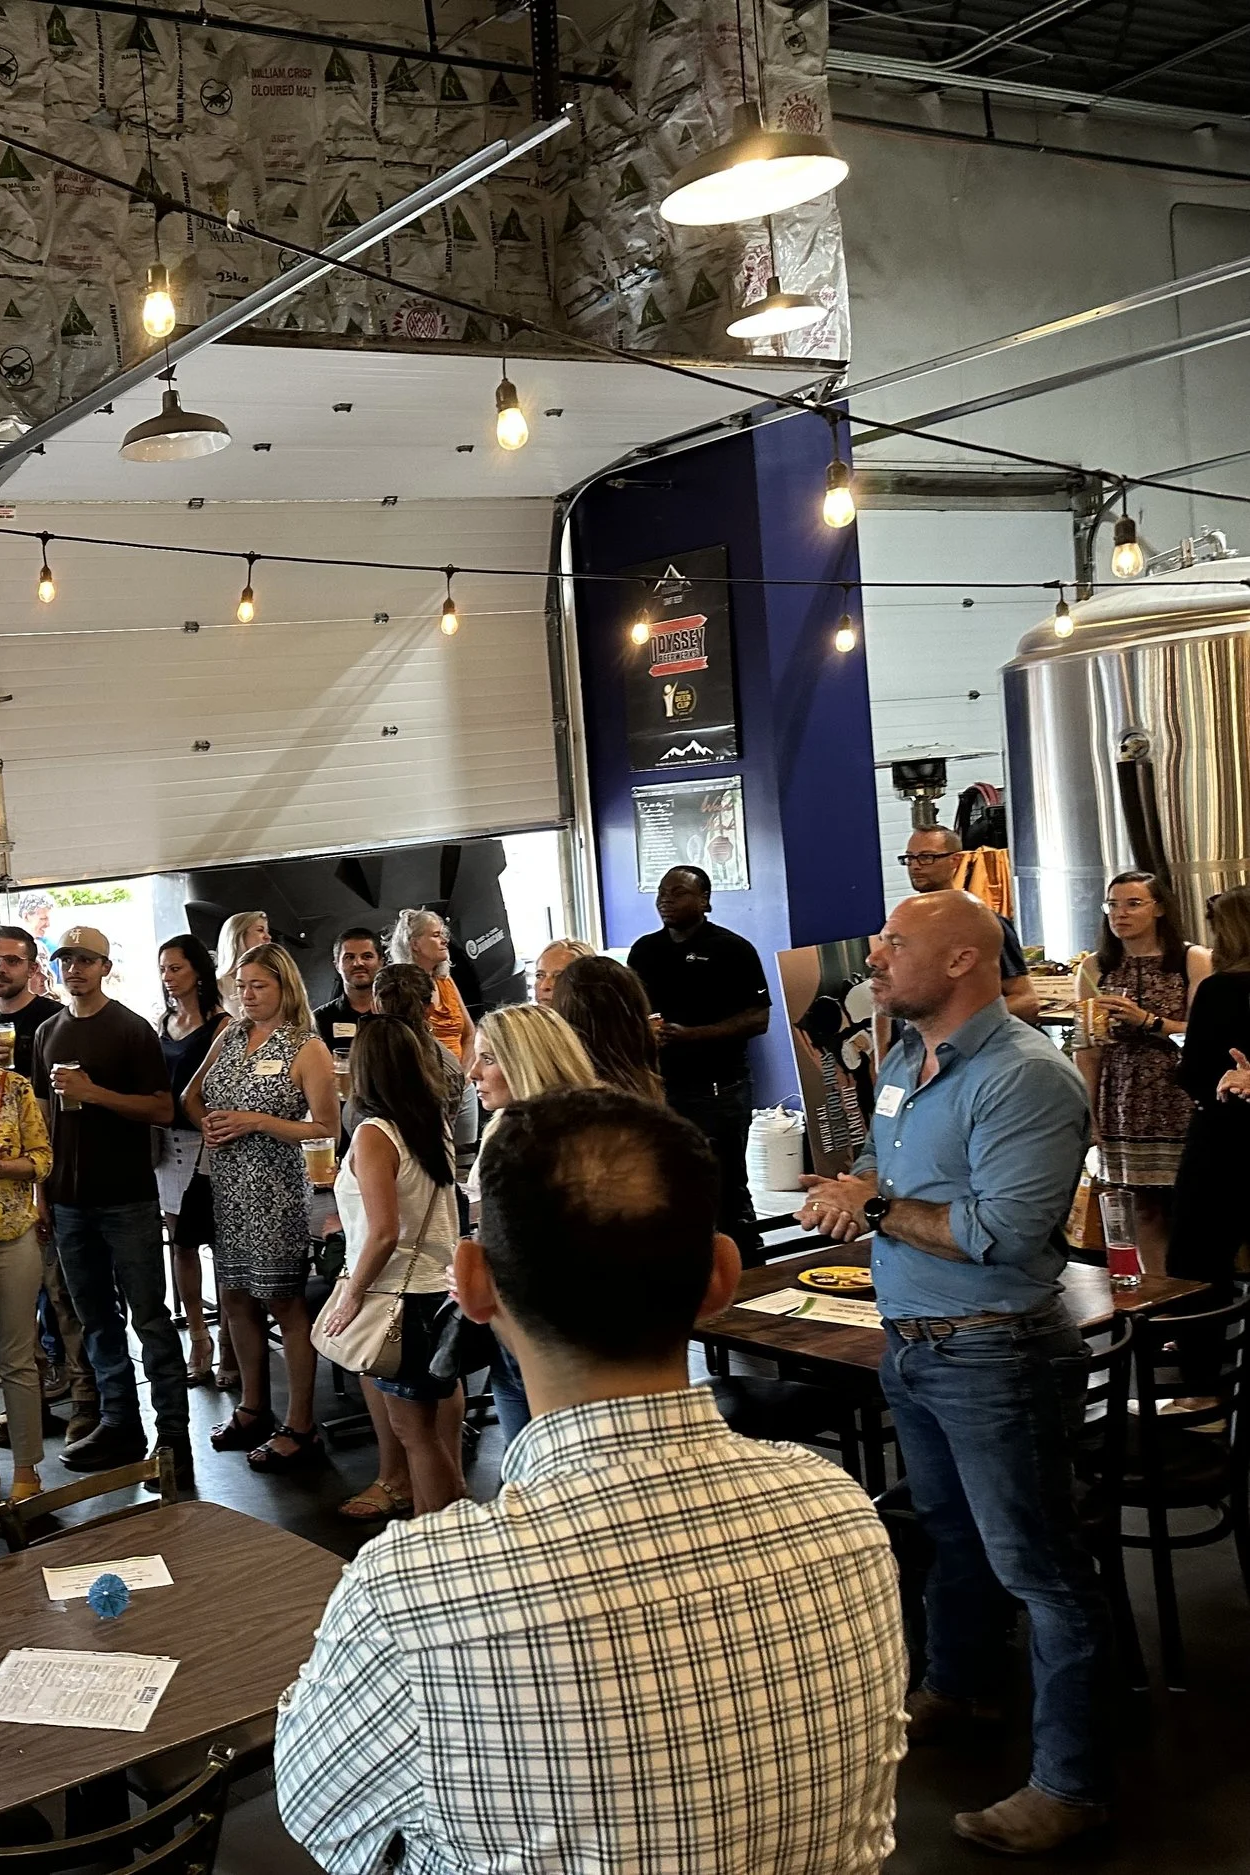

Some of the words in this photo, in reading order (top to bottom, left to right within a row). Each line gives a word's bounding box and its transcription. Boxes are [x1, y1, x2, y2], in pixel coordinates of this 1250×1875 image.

[251, 67, 286, 79] WILLIAM
[287, 68, 312, 79] CRISP
[366, 53, 378, 89] COMPANY
[251, 85, 294, 97] OLOURED
[296, 86, 317, 98] MALT
[210, 233, 244, 244] MALT
[650, 627, 706, 664] ODYSSEY
[677, 701, 690, 709] CUP
[842, 1085, 858, 1110] OUT
[816, 1104, 830, 1121] ALL
[818, 1120, 834, 1154] WHERE
[831, 1123, 849, 1151] THE
[846, 1111, 865, 1146] HANG
